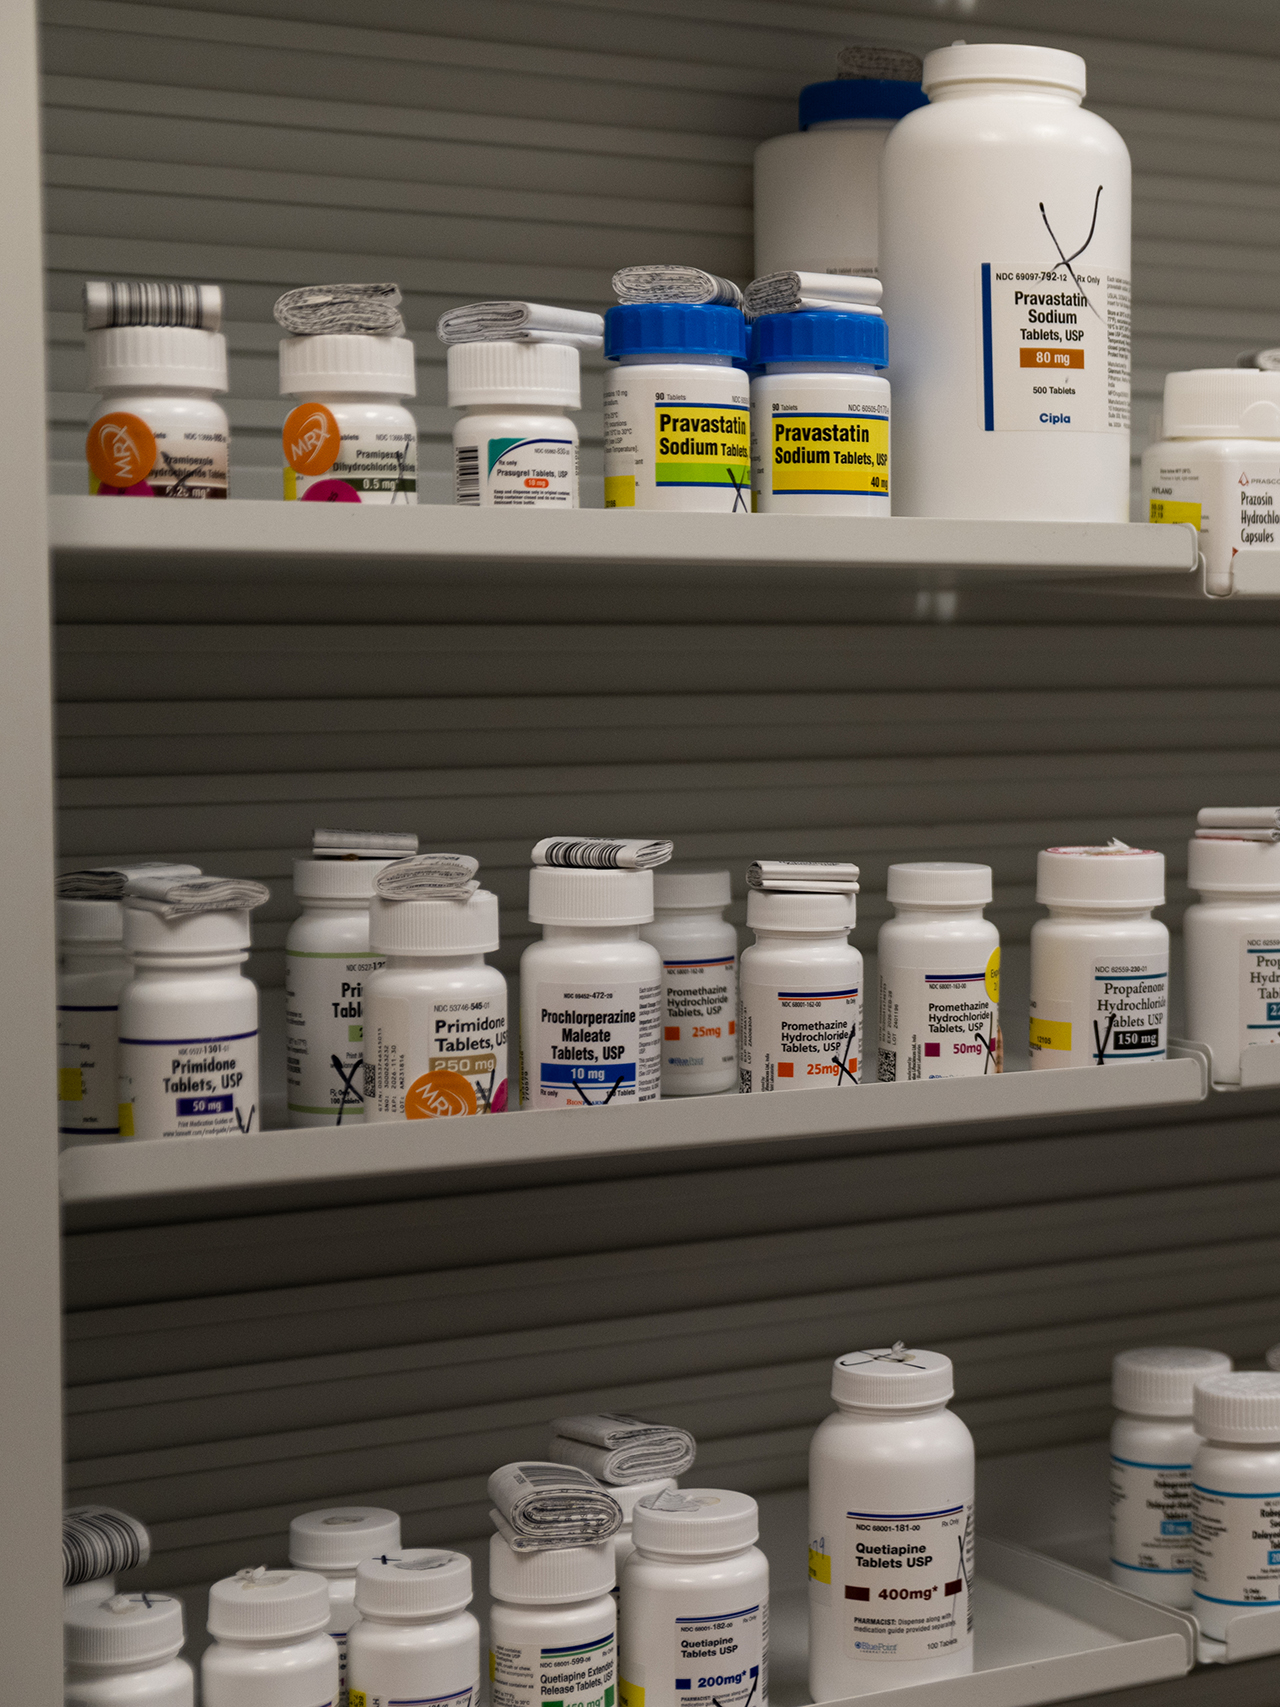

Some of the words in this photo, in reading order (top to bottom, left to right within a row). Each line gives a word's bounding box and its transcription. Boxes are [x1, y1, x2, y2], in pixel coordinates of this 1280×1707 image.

[996, 273, 1013, 281] NDC
[1015, 272, 1068, 282] 69097-792-12
[1087, 276, 1101, 286] Only
[1015, 291, 1088, 308] Pravastatin
[1028, 309, 1077, 325] Sodium
[1020, 328, 1063, 343] Tablets,
[1065, 329, 1085, 342] USP
[1036, 351, 1051, 363] 80
[1054, 352, 1070, 367] mg
[1033, 386, 1047, 394] 500
[1049, 386, 1076, 395] Tablets
[772, 403, 780, 411] 90
[660, 414, 746, 435] Pravastatin
[1039, 412, 1071, 425] Cipla
[775, 424, 869, 443] Pravastatin
[291, 428, 330, 461] MRX
[659, 437, 718, 456] Sodium
[775, 446, 830, 464] Sodium
[834, 451, 874, 467] Tablets,
[876, 452, 887, 466] USP
[497, 469, 530, 478] Prasugrel
[532, 469, 557, 478] Tablets,
[558, 470, 568, 478] USP
[363, 479, 379, 489] 0.5
[871, 476, 880, 488] 40
[881, 479, 888, 491] mg
[1241, 491, 1273, 506] Prazosin
[1241, 528, 1274, 545] Capsules
[667, 985, 727, 997] Promethazine
[1104, 981, 1165, 998] Propafenone
[449, 1002, 490, 1012] 53746-545-01
[667, 996, 728, 1008] Hydrochloride
[928, 1001, 989, 1012] Promethazine
[1097, 997, 1166, 1014] Hydrochloride
[541, 1009, 636, 1027] Prochlorperazine
[667, 1008, 703, 1017] Tablets,
[706, 1006, 722, 1016] USP
[928, 1011, 990, 1024] Hydrochloride
[435, 1016, 505, 1034] Primidone
[781, 1020, 848, 1031] Promethazine
[1105, 1015, 1145, 1027] Tablets
[1148, 1012, 1163, 1026] USP
[692, 1026, 721, 1038] 25mg
[928, 1024, 965, 1033] Tablets,
[968, 1022, 984, 1032] USP
[562, 1028, 611, 1043] Maleate
[781, 1030, 849, 1044] Hydrochloride
[1118, 1033, 1138, 1045] 150
[1141, 1033, 1157, 1046] mg
[435, 1037, 494, 1052] Tablets,
[781, 1043, 820, 1053] Tablets,
[823, 1042, 841, 1052] USP
[953, 1043, 982, 1055] 50mg
[551, 1046, 599, 1063] Tablets,
[603, 1046, 625, 1061] USP
[172, 1056, 236, 1074] Primidone
[434, 1059, 470, 1072] 250
[475, 1058, 494, 1072] mg
[807, 1063, 840, 1077] 25mg
[571, 1068, 585, 1079] 10
[588, 1070, 605, 1081] mg
[163, 1077, 217, 1093] Tablets,
[221, 1072, 243, 1089] USP
[193, 1101, 205, 1112] 50
[207, 1101, 221, 1113] mg
[872, 1524, 920, 1532] 68001-181-00
[949, 1518, 960, 1526] Only
[855, 1542, 927, 1556] Quetiapine
[855, 1556, 903, 1569] Tablets
[907, 1556, 933, 1567] USP
[1271, 1553, 1280, 1563] 20
[854, 1617, 897, 1626] PHARMACIST:
[898, 1617, 925, 1626] Dispense
[926, 1615, 941, 1625] along
[854, 1625, 887, 1634] medication
[888, 1626, 905, 1635] guide
[905, 1625, 931, 1634] provided
[681, 1637, 734, 1649] Quetiapine
[861, 1641, 898, 1651] BluePoint
[927, 1642, 938, 1650] 100
[939, 1638, 958, 1648] Tablets
[681, 1650, 717, 1659] Tablets
[719, 1645, 738, 1655] USP
[540, 1670, 586, 1685] Quetiapine
[540, 1684, 575, 1696] Release
[576, 1678, 603, 1692] Tablets,
